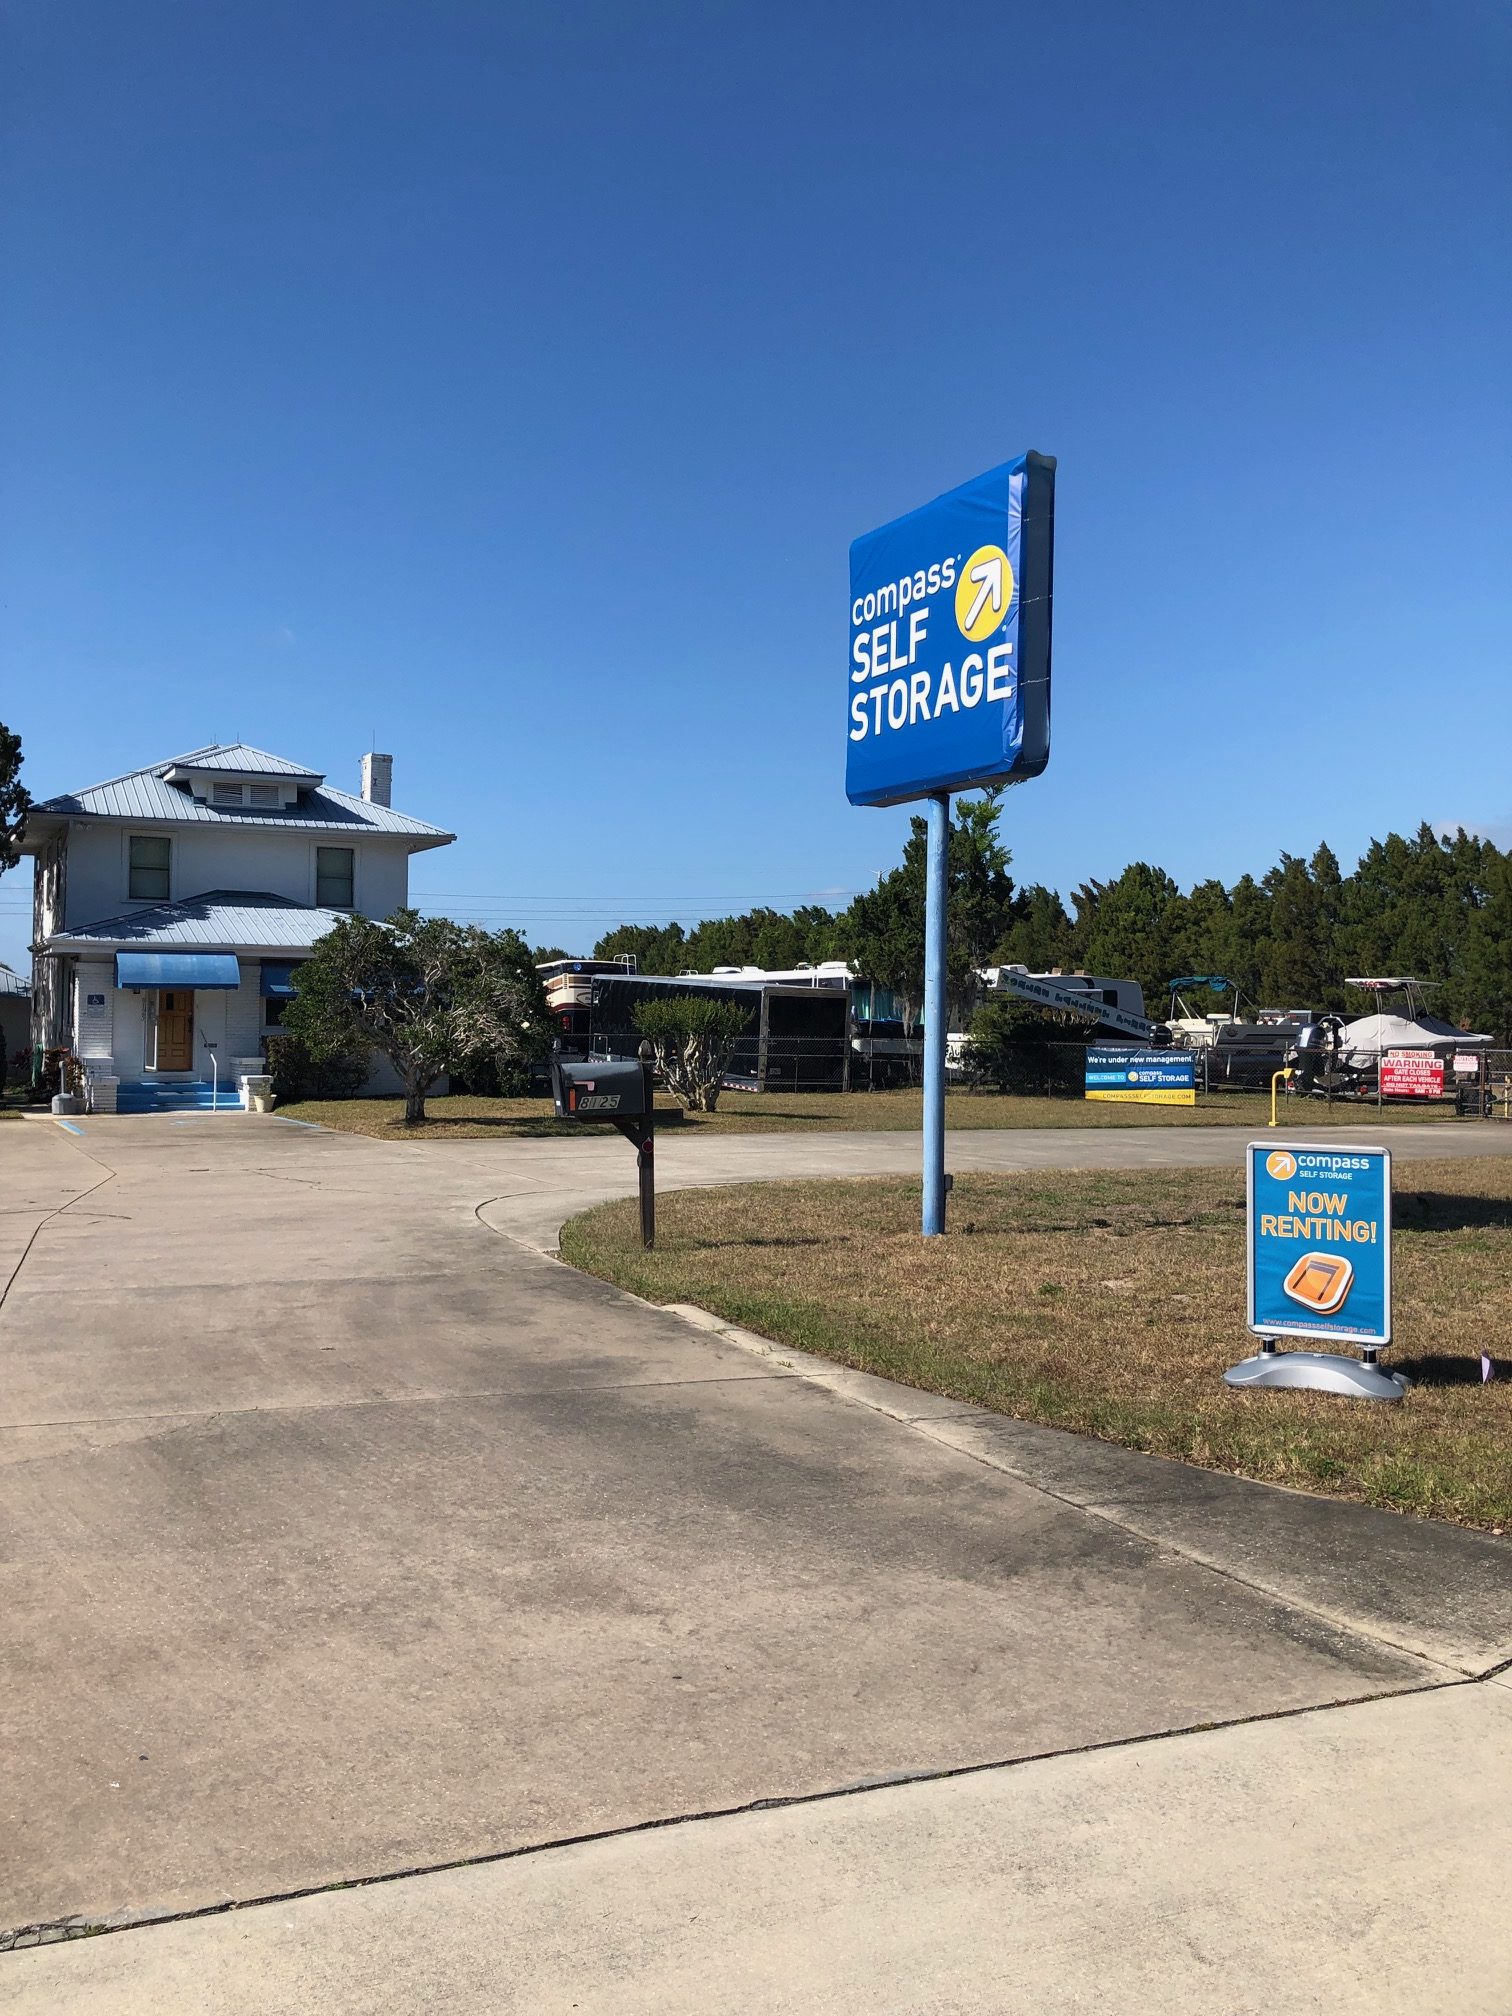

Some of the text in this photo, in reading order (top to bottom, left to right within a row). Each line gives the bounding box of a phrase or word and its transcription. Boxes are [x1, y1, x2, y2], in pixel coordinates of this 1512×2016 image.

[852, 556, 956, 626] compass
[851, 607, 930, 684] SELF
[850, 643, 1014, 742] STORAGE
[1088, 1056, 1106, 1064] We're
[1108, 1056, 1128, 1064] under
[1383, 1059, 1442, 1068] WARNING
[1298, 1156, 1370, 1171] compass
[1319, 1171, 1353, 1180] STORAGE
[1288, 1191, 1348, 1215] NOW
[1261, 1214, 1376, 1244] RENTING!
[1263, 1318, 1376, 1334] www.compassselfstorage.com
